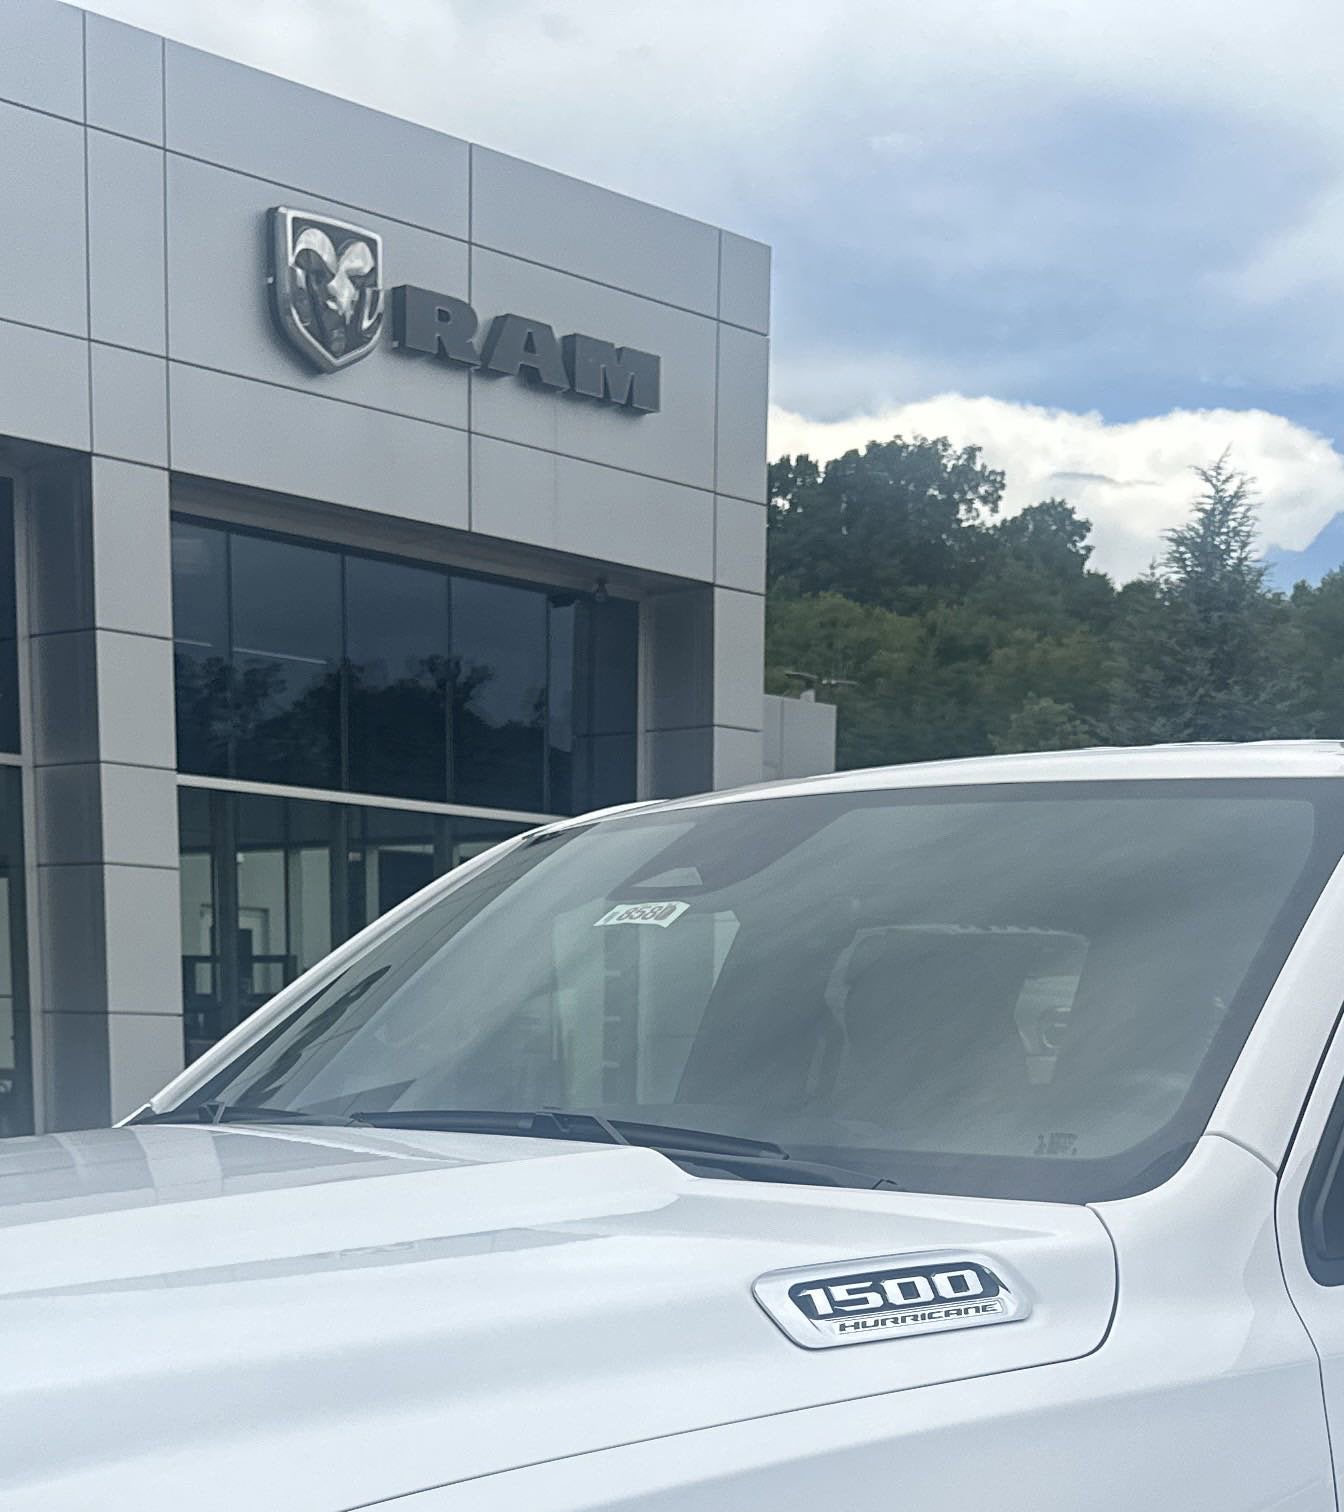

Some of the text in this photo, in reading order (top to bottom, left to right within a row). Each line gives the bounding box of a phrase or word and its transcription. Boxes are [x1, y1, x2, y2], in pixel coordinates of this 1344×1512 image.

[392, 284, 661, 414] RAM
[798, 1268, 984, 1316] 1500
[838, 1301, 999, 1332] HURRICANE
